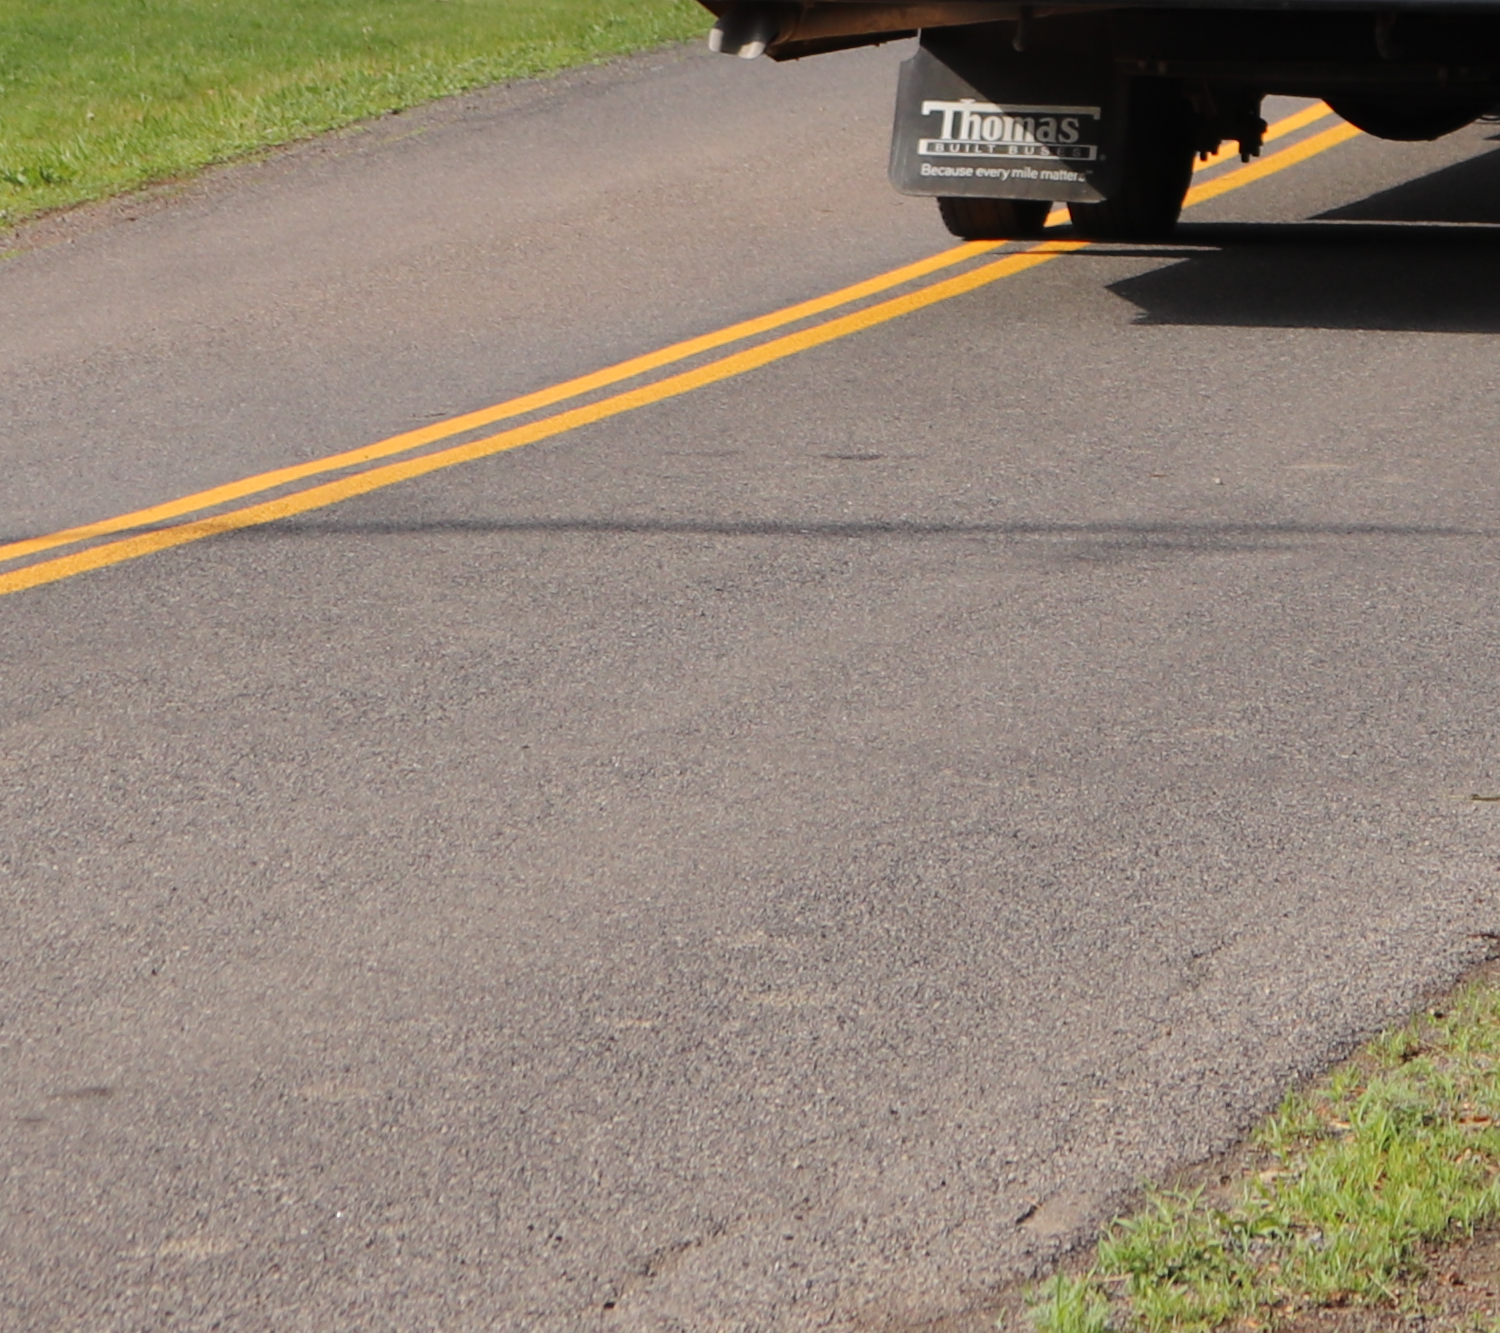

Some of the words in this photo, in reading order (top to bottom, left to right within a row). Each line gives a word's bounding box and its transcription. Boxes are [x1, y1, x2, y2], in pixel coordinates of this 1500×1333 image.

[921, 98, 1101, 144] Thomas
[934, 143, 997, 154] BUILT
[1008, 146, 1083, 157] BUSES
[920, 163, 974, 177] Because
[975, 165, 1010, 181] every
[1011, 167, 1038, 180] mile
